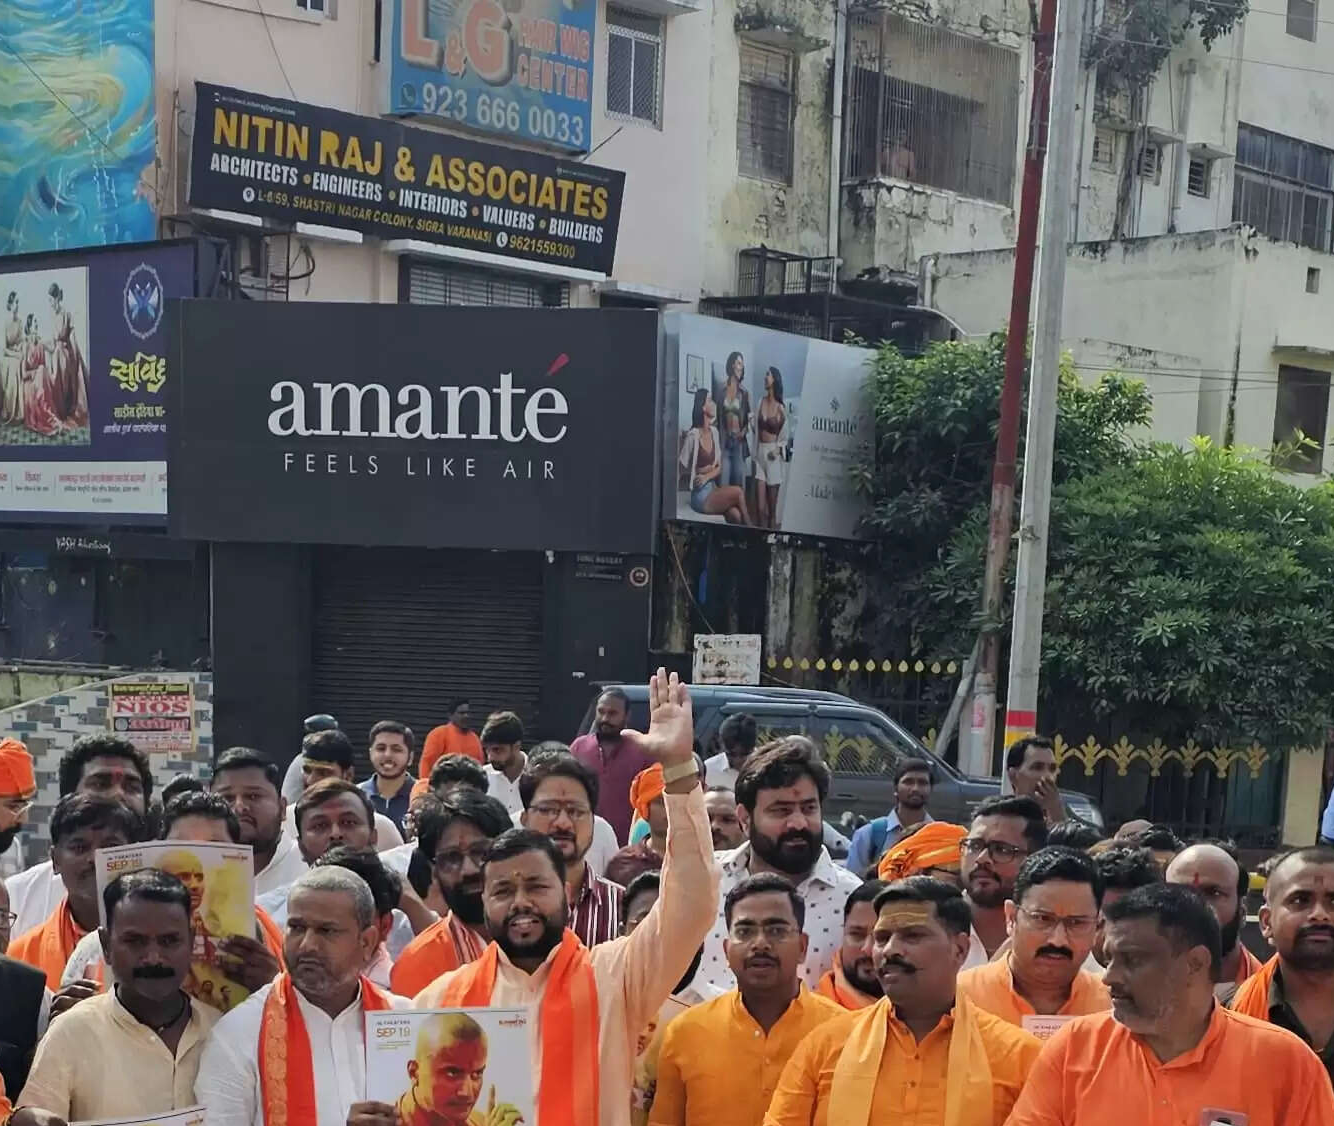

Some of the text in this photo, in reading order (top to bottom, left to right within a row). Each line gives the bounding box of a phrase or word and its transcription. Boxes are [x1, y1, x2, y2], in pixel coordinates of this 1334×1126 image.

[401, 0, 514, 87] L & G
[517, 53, 589, 102] CENTER
[423, 82, 585, 146] 923 666 0033
[213, 107, 609, 221] NITIN RAJ & ASSOCIATES
[210, 152, 604, 244] ARCHITECTS ENGINEERS INTERIORS VALUERS BUILDERS
[292, 195, 336, 213] SHASTRI
[338, 203, 372, 220] NAGAR
[415, 218, 444, 236] SIGRA
[446, 223, 493, 242] VARANASI
[267, 352, 571, 443] amanté
[283, 452, 555, 479] FEELS LIKE AIR
[116, 701, 188, 713] NIOS
[106, 860, 128, 872] SEP
[376, 1026, 411, 1038] SEP 19
